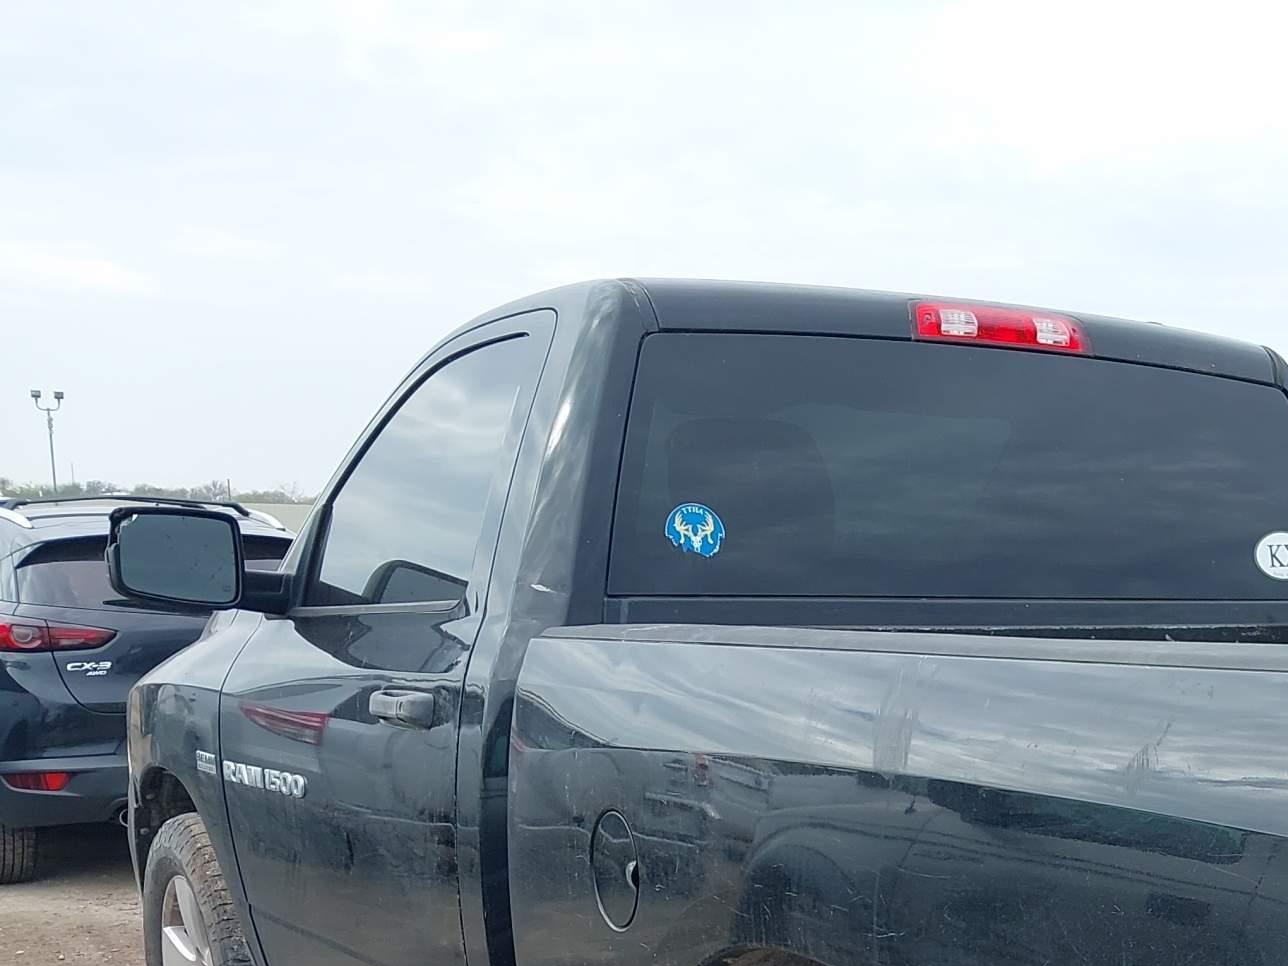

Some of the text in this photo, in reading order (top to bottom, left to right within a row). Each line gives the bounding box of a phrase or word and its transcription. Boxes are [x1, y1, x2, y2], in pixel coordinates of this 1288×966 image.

[66, 661, 112, 671] CX-3
[222, 760, 307, 799] RAM 1500
